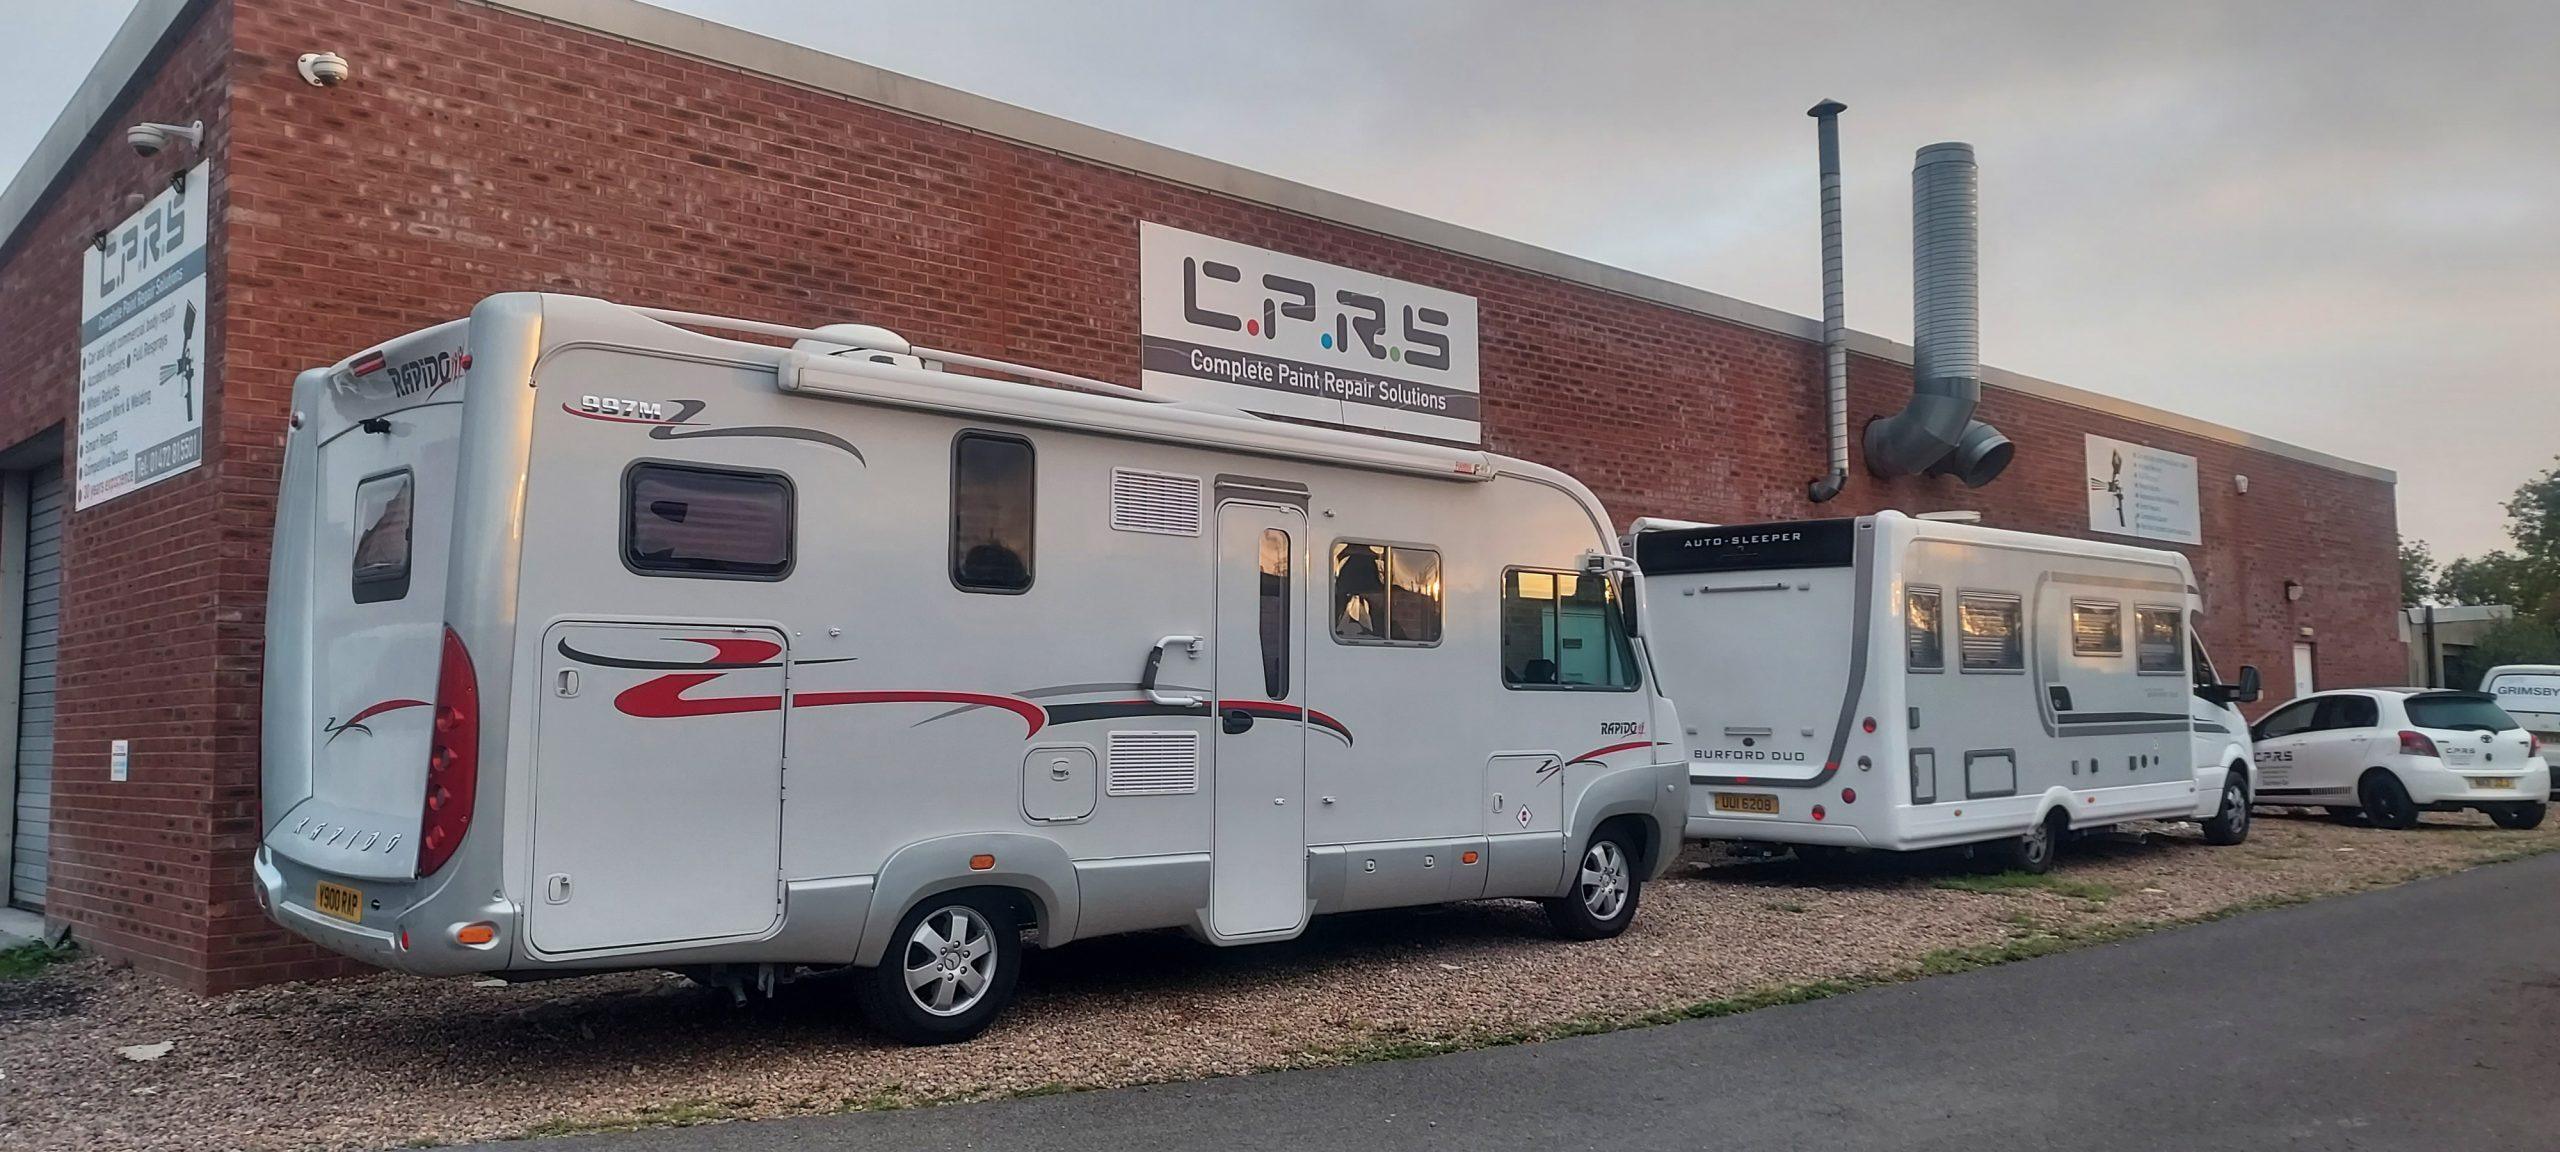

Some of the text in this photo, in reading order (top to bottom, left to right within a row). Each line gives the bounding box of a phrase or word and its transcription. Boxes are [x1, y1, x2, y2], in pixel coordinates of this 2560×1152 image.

[155, 267, 182, 294] Solutions
[1191, 349, 1447, 410] Complete Paint Repair Solutions
[582, 395, 661, 419] 997M
[1684, 532, 1801, 548] AUTO-SLEEPER
[2498, 686, 2560, 696] GRIMSBY
[1694, 750, 1805, 761] BURFORD DUO
